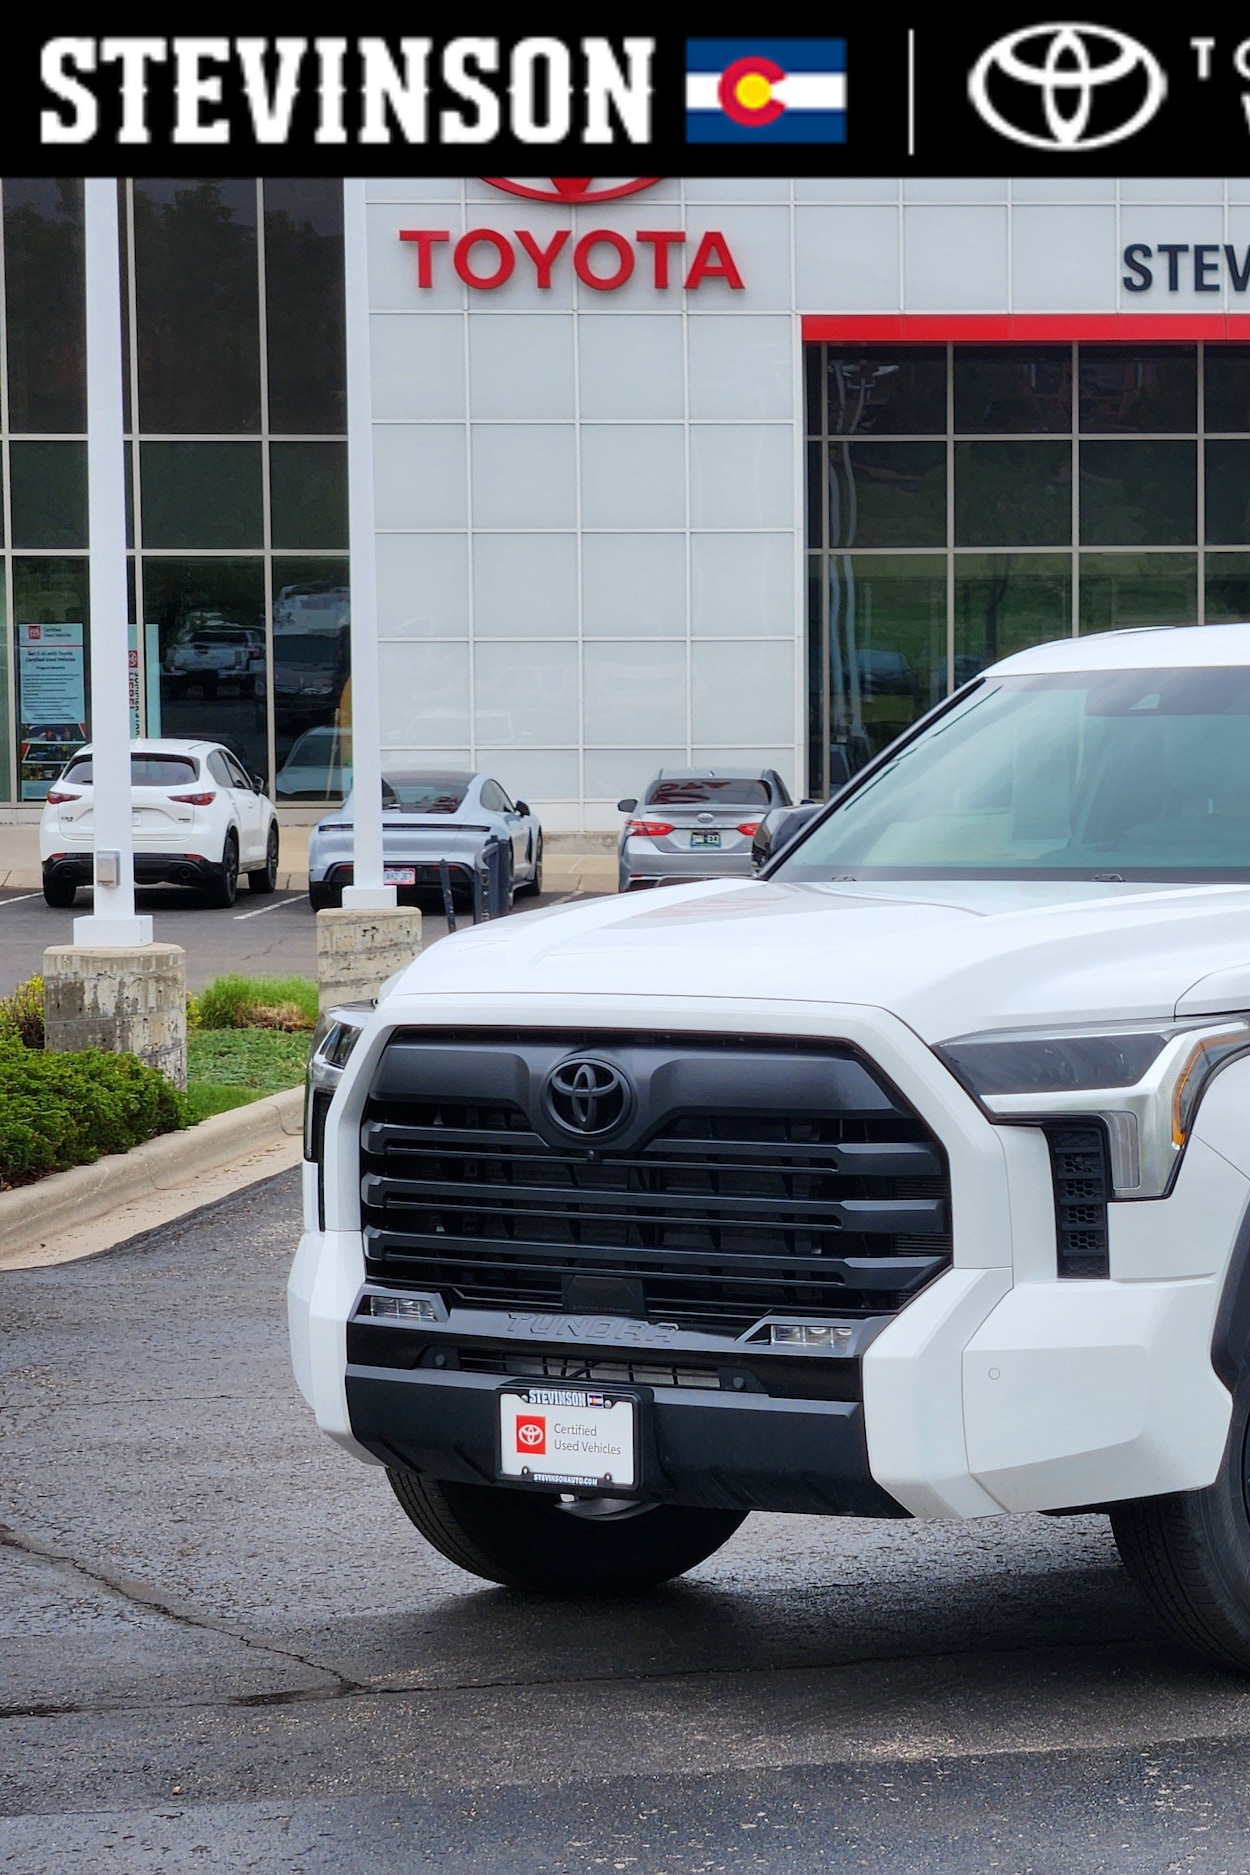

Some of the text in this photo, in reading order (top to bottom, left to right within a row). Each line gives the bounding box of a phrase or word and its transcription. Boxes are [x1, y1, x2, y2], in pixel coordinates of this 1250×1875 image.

[399, 228, 744, 291] TOYOTA
[505, 1312, 680, 1344] TUNDRA
[528, 1389, 587, 1408] STEVINSON
[553, 1423, 597, 1437] Certified
[553, 1439, 621, 1456] Used Vehicles
[533, 1473, 598, 1487] STEVINSONAUTO.COM
